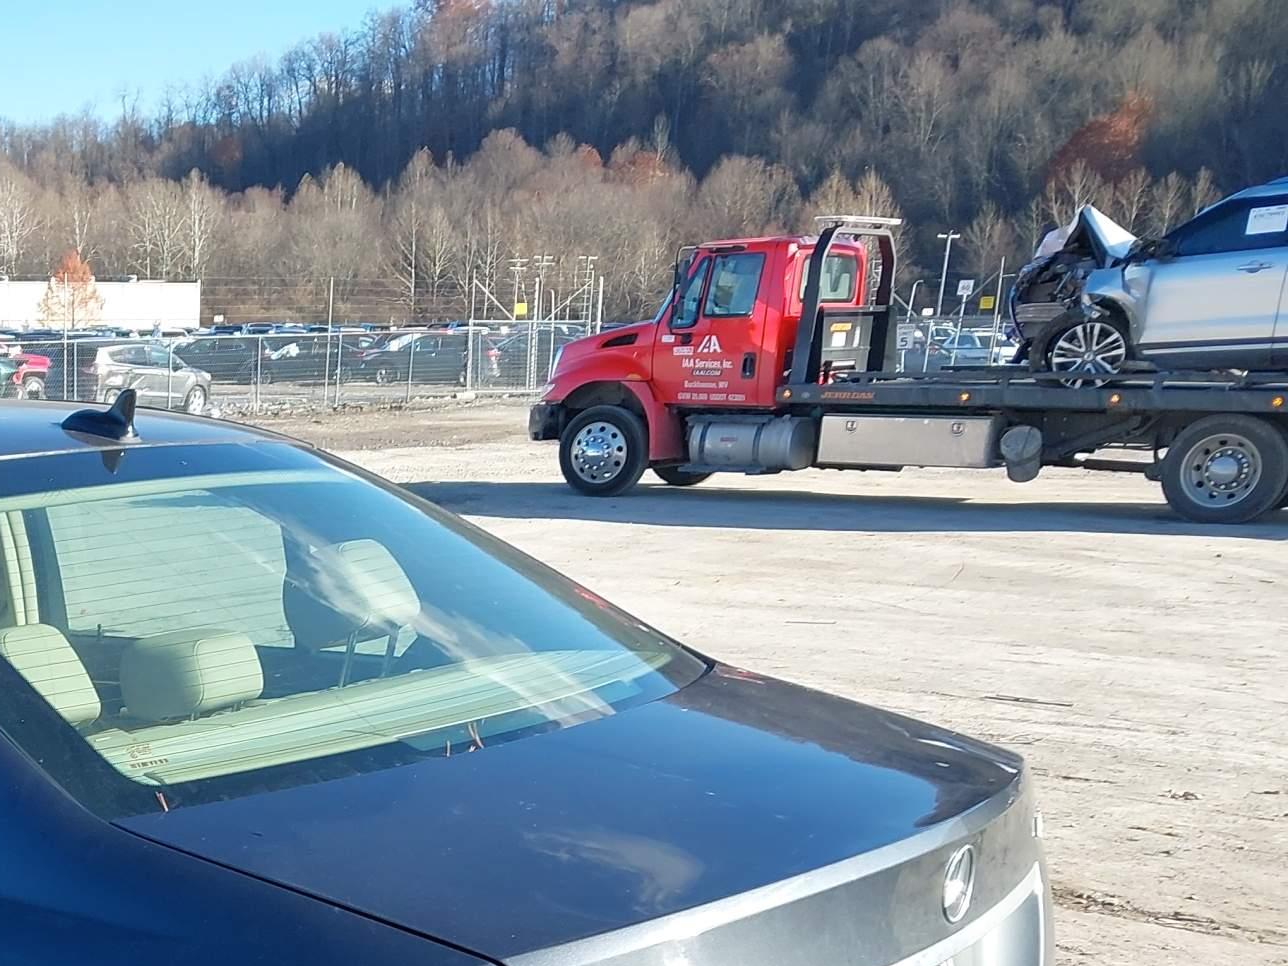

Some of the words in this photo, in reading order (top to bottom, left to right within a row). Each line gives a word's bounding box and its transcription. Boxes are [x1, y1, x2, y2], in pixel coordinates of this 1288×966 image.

[900, 336, 908, 347] 5
[682, 358, 694, 368] IAA
[723, 359, 733, 369] Inc.
